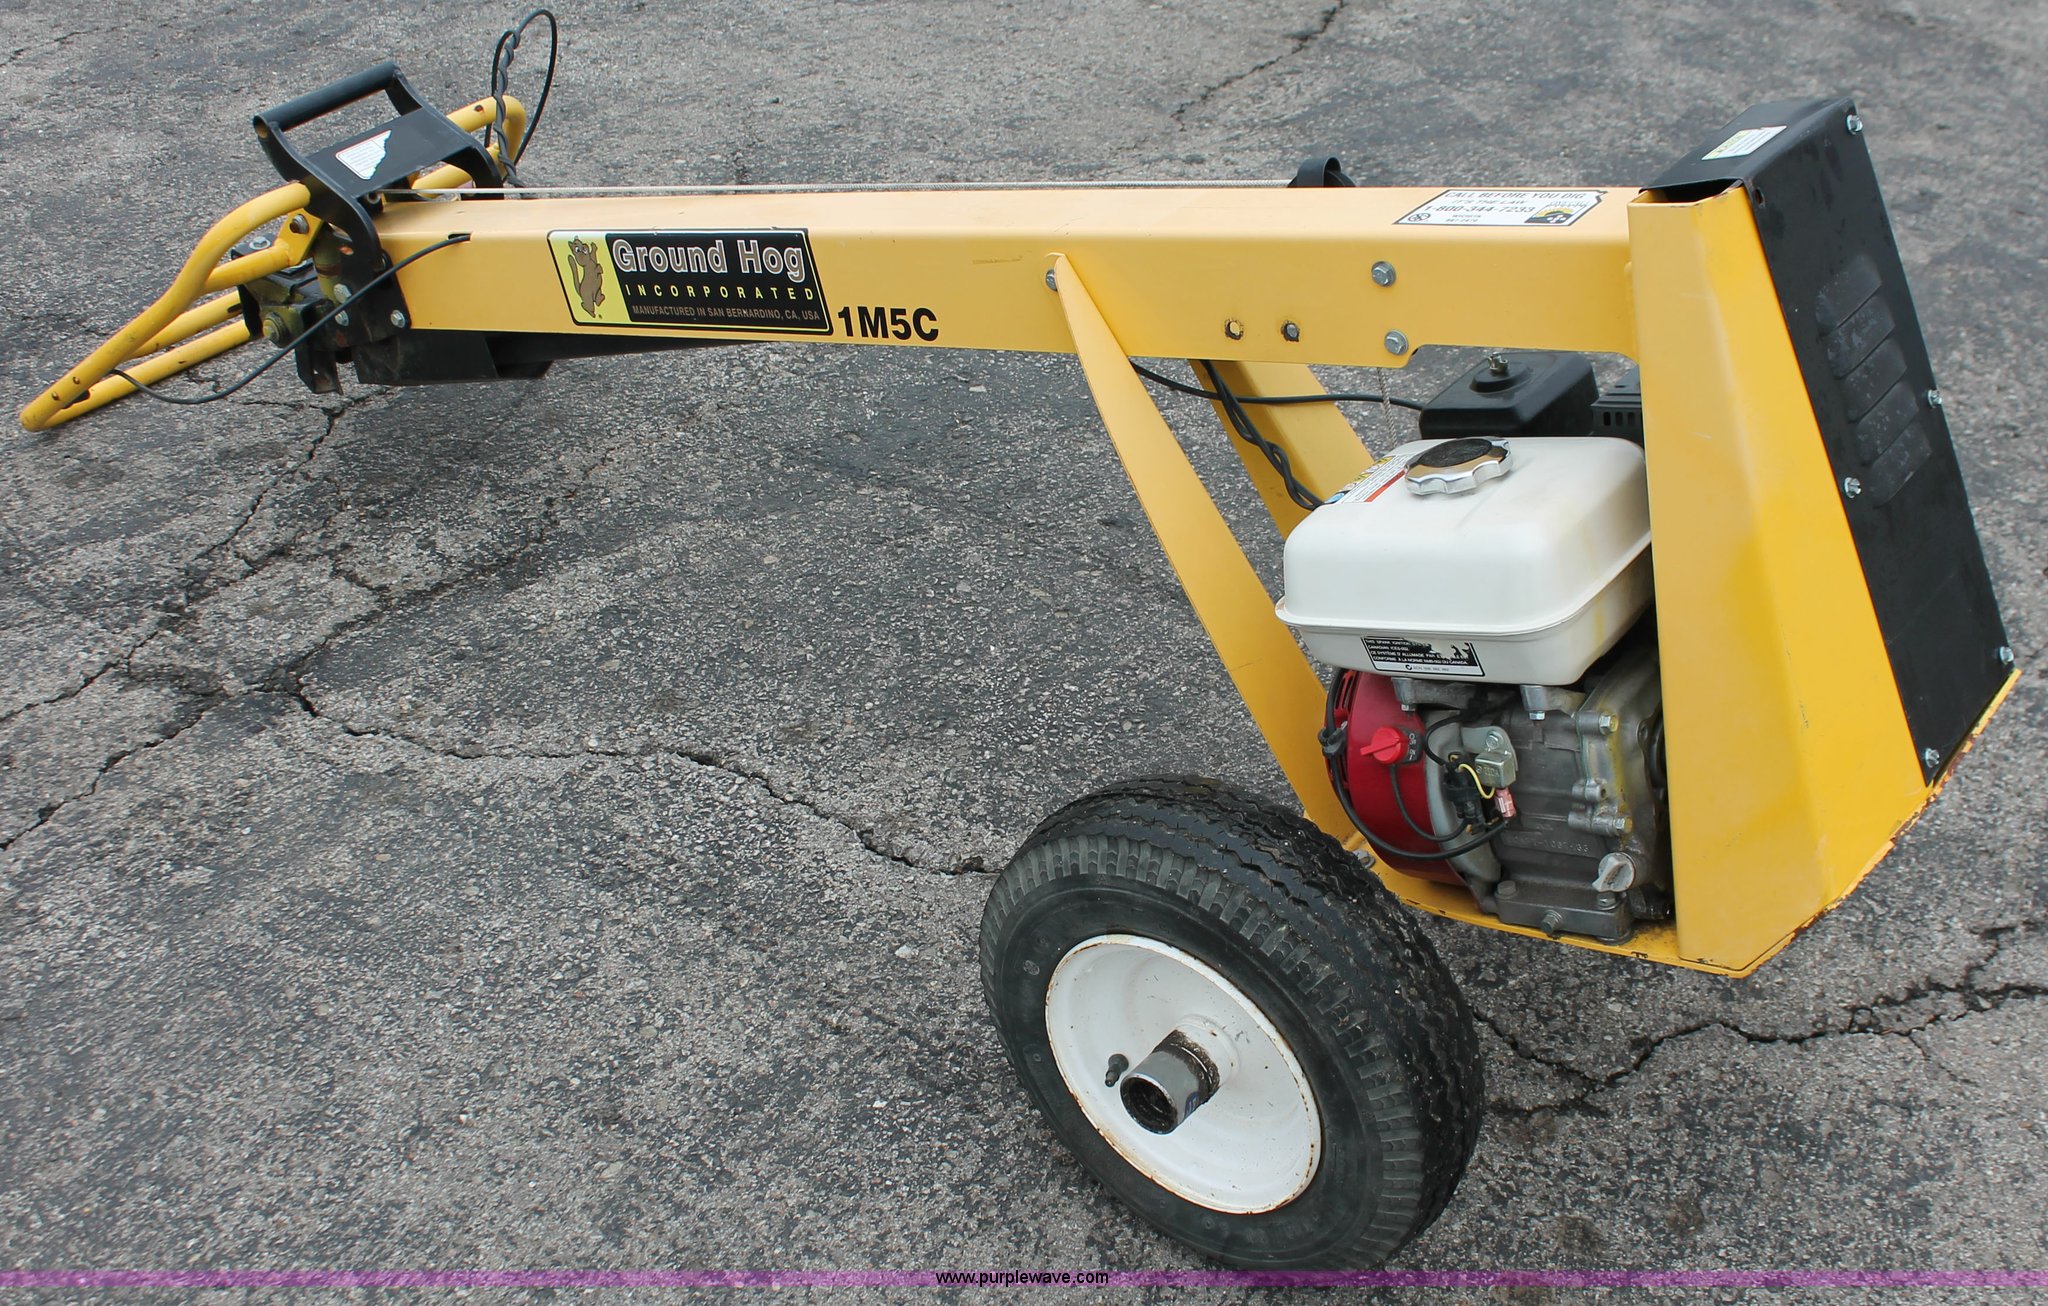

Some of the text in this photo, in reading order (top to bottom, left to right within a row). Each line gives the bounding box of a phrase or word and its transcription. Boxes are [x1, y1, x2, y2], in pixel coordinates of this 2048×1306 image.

[1444, 191, 1476, 199] CALL
[1478, 191, 1531, 199] BEFORE
[1424, 205, 1536, 213] 1-800-344-7233
[612, 238, 806, 284] Ground Hog
[625, 284, 814, 301] INCORPORATED
[632, 305, 820, 321] MANUFACTURED IN SAN BERNARDINO, CA, USA
[837, 306, 939, 342] 1M5C
